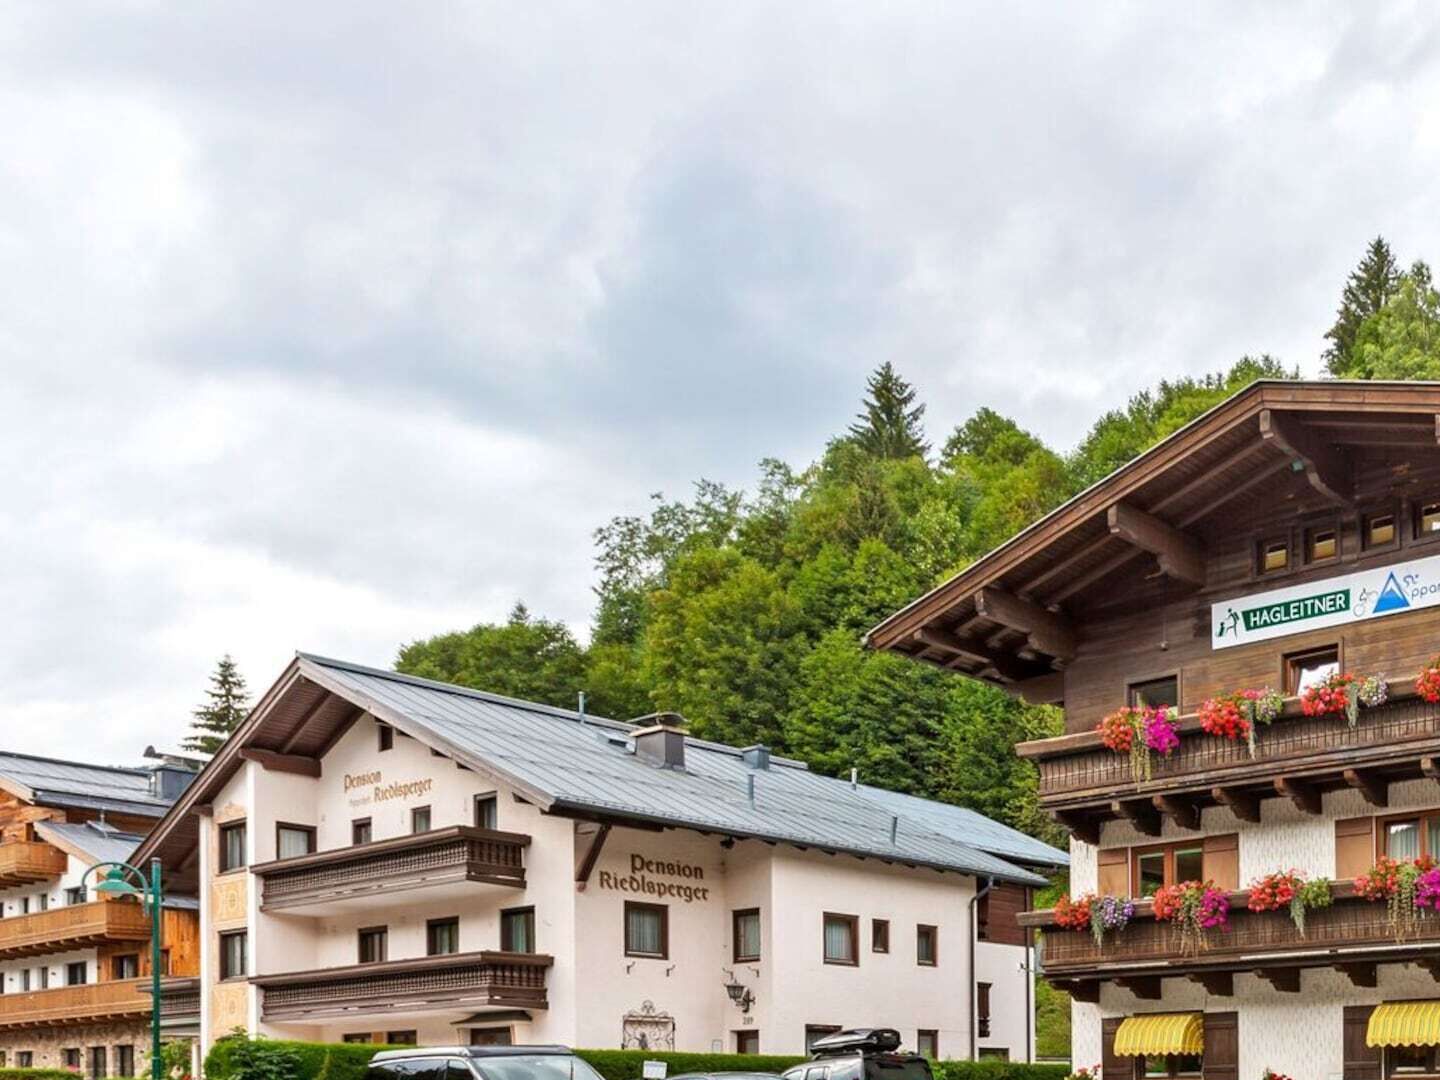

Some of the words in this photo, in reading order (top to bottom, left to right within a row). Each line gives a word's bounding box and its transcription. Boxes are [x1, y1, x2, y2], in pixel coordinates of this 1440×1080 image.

[1250, 594, 1346, 628] HAGLEITNER
[344, 771, 381, 793] Pension
[630, 854, 704, 880] Pension
[599, 870, 709, 903] Riedlsperger
